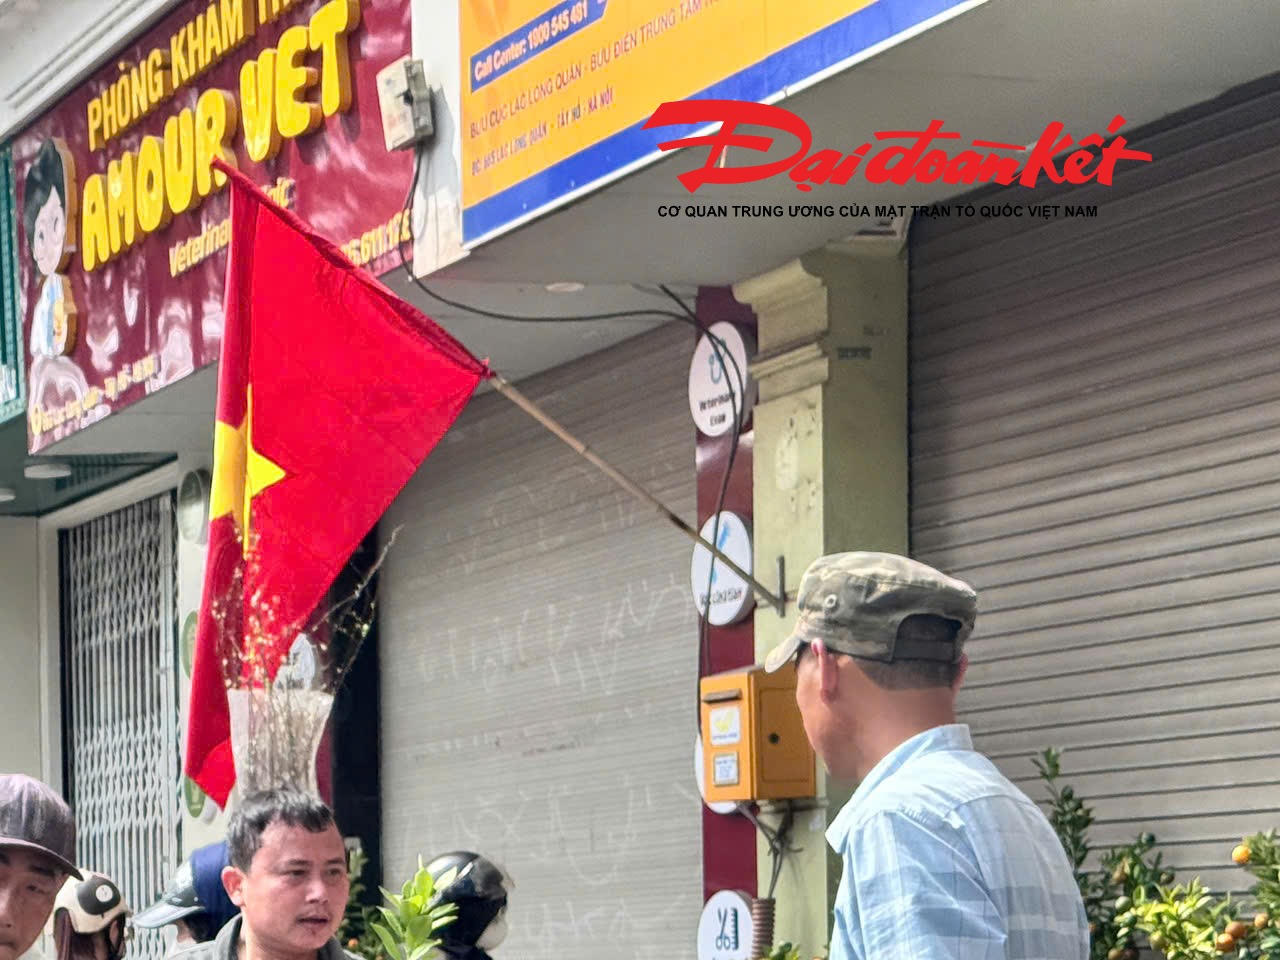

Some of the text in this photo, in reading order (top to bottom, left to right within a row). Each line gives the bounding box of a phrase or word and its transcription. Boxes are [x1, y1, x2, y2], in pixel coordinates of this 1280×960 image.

[641, 10, 676, 43] TRUNG
[82, 0, 350, 273] AMOUR VET
[87, 48, 167, 152] PHÒNG
[169, 217, 232, 278] Veterina
